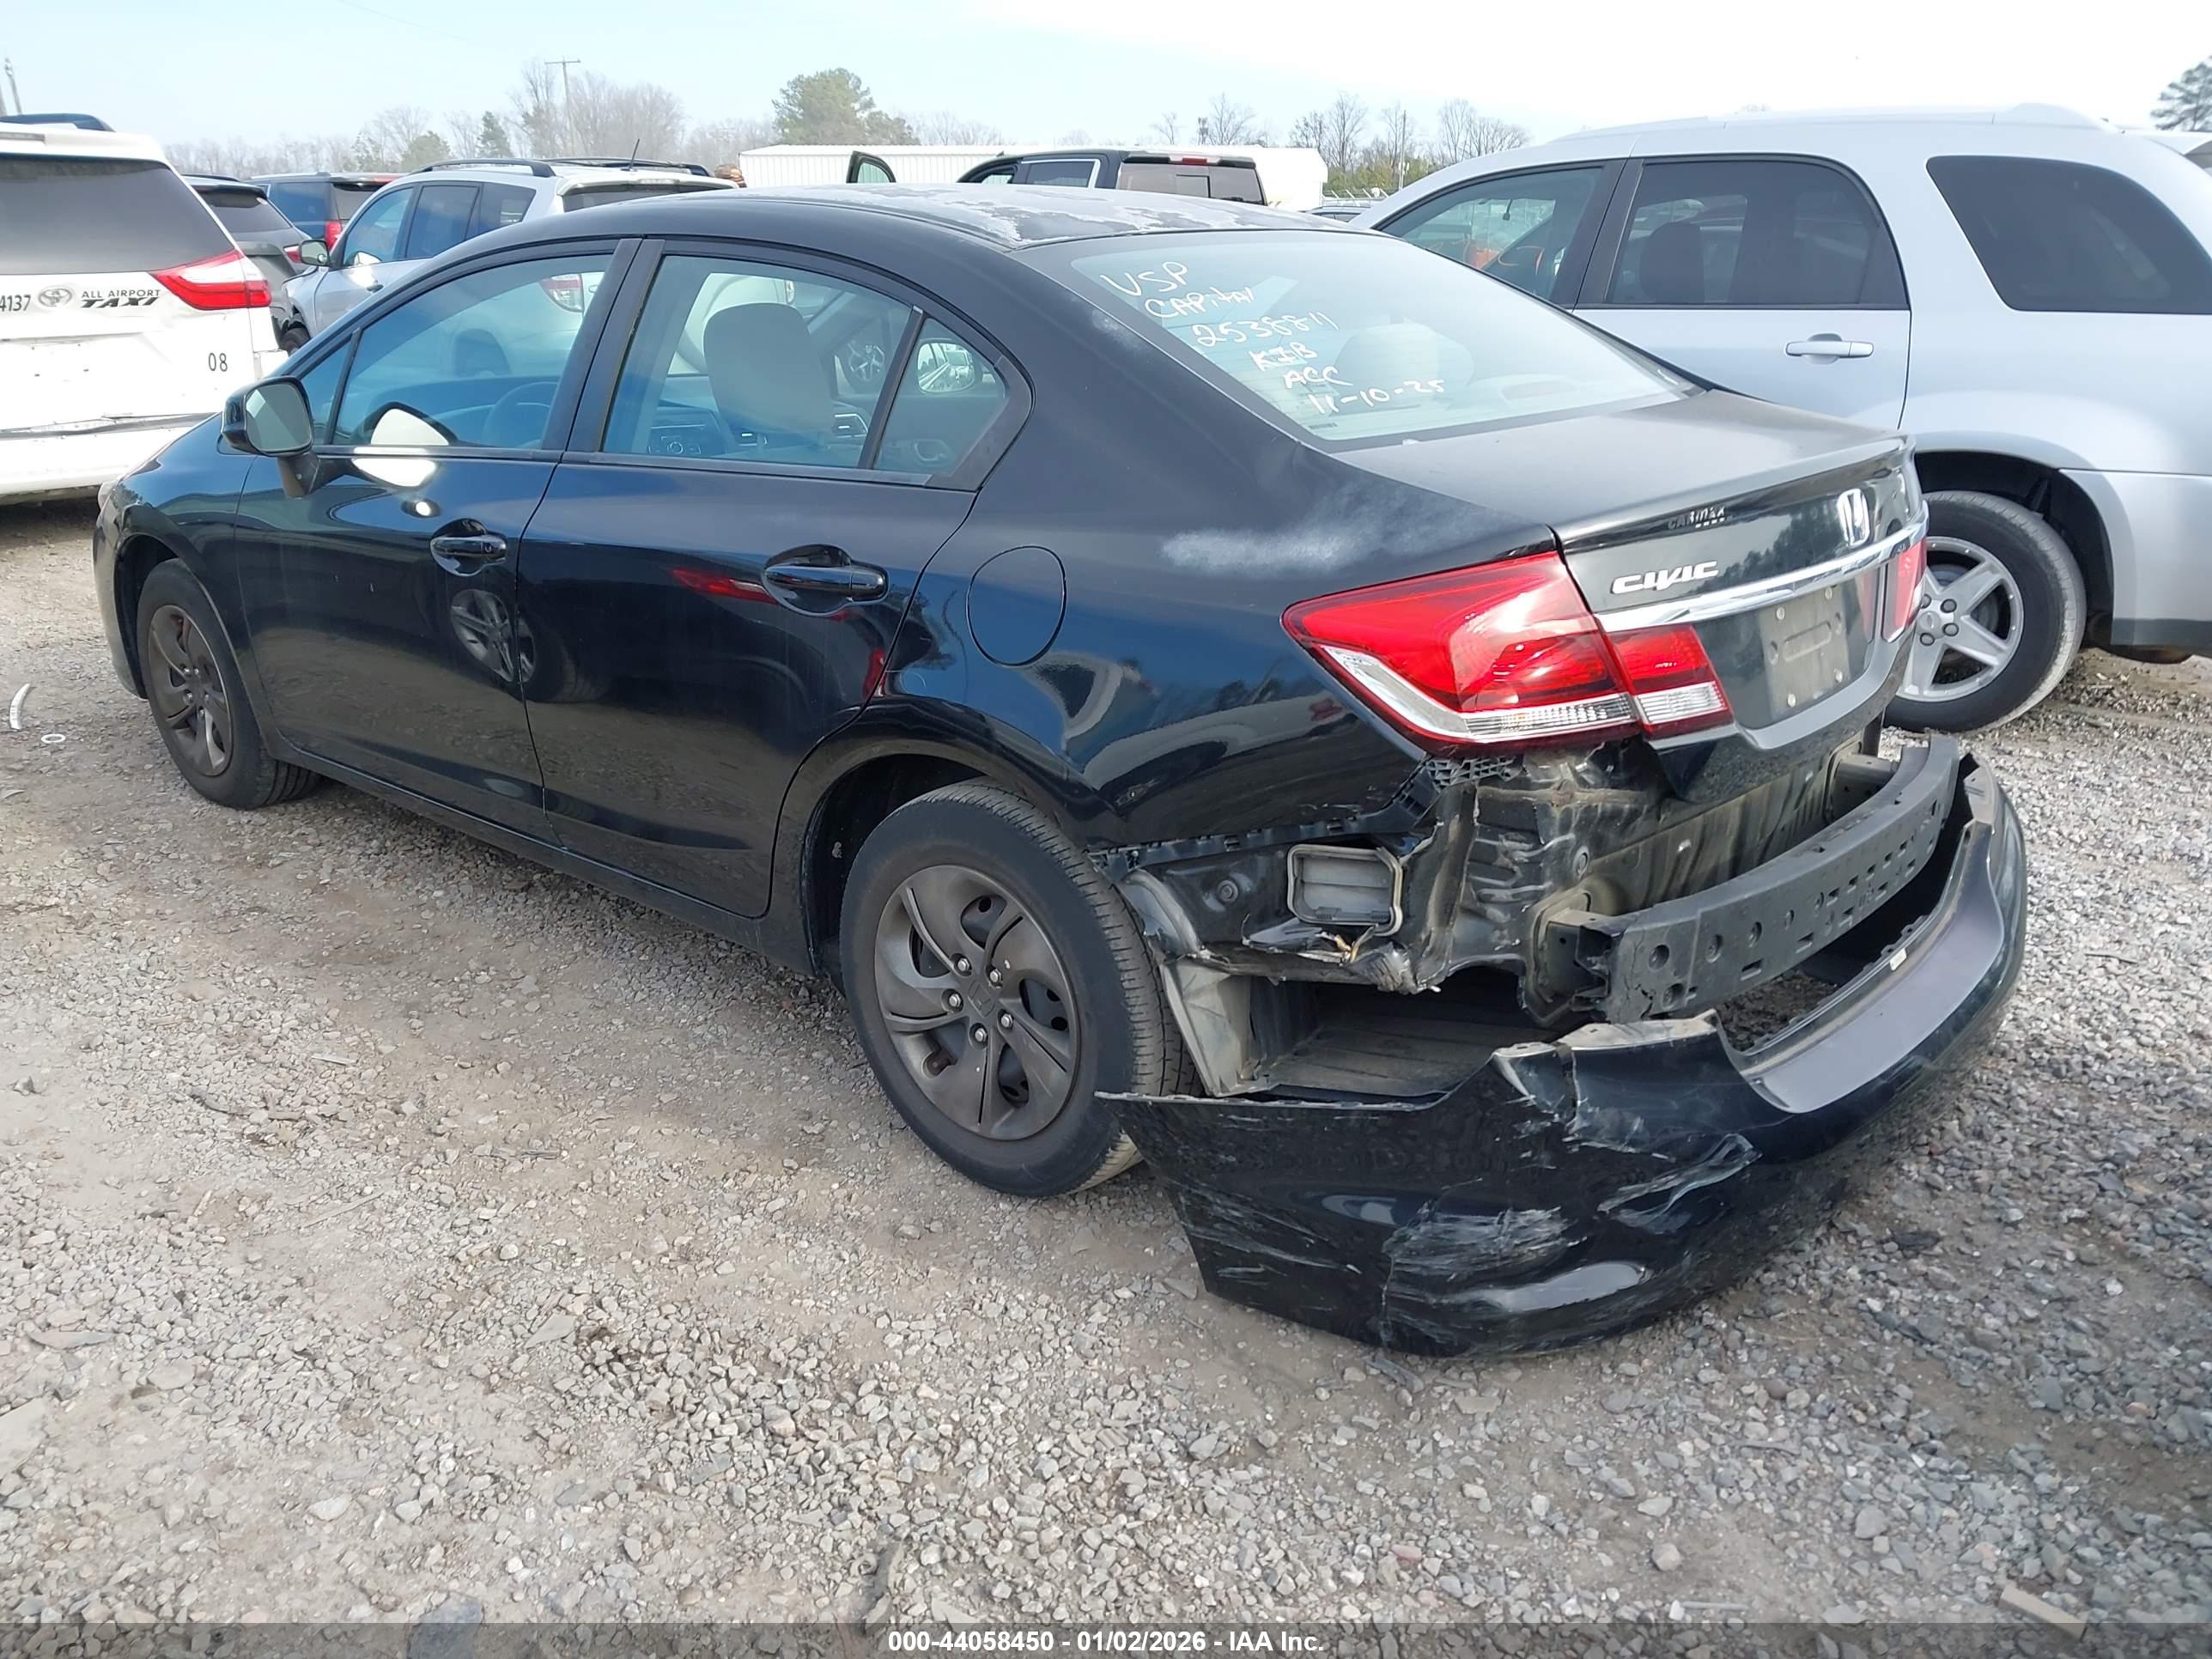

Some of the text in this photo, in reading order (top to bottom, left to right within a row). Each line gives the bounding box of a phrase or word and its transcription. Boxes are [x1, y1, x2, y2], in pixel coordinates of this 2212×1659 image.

[81, 296, 159, 308] TAXI
[208, 352, 228, 372] 08
[1610, 560, 1719, 594] CIVIC
